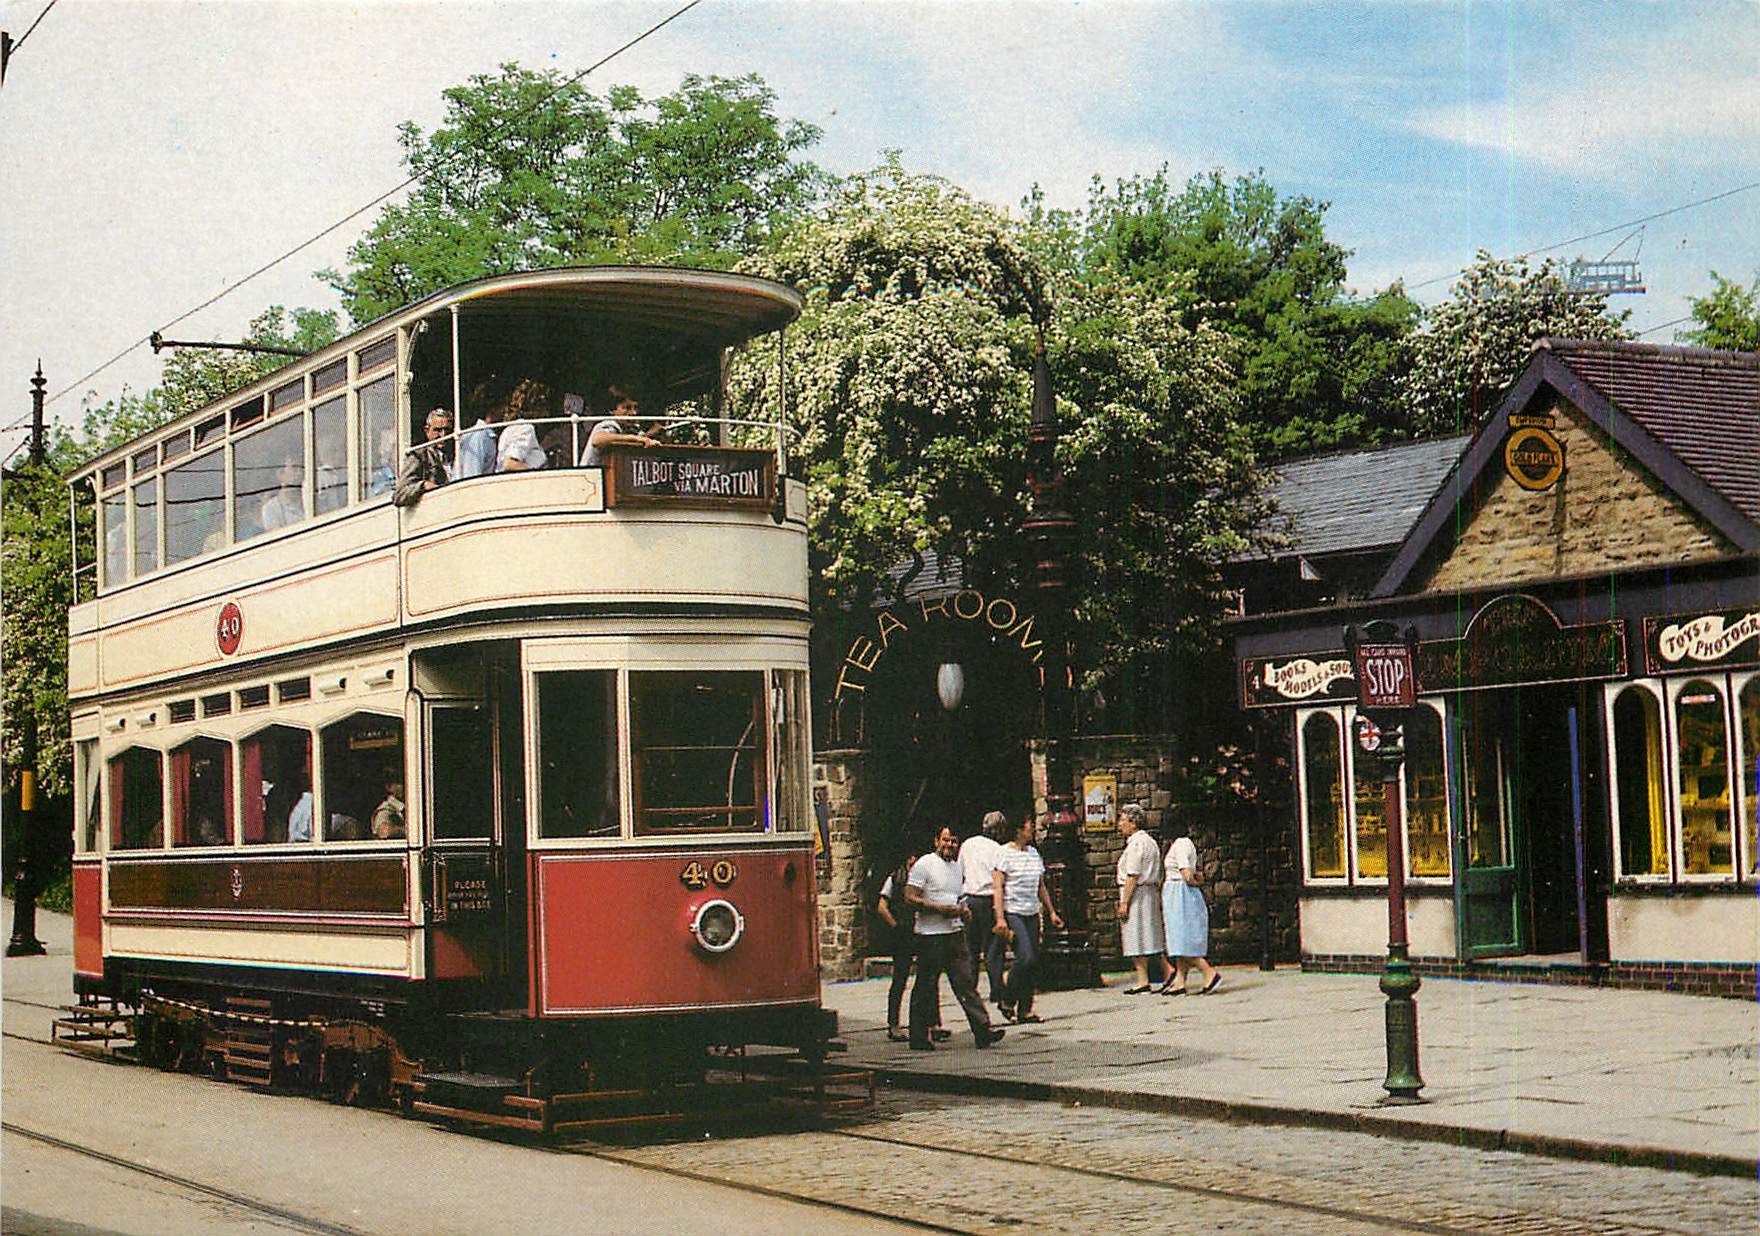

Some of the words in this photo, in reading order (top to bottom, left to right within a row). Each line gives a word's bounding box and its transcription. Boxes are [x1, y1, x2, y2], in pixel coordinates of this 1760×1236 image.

[632, 460, 674, 487] TALBOT
[678, 462, 720, 480] SQUARE
[673, 481, 692, 493] VIA
[695, 469, 759, 496] MARTON
[221, 616, 240, 638] 40
[1666, 622, 1701, 653] TOYS
[835, 611, 909, 700] TEA
[1274, 661, 1309, 684] BOOKS
[1284, 671, 1323, 694] MODELS
[1329, 661, 1355, 676] SOU
[1366, 658, 1404, 695] STOP
[453, 880, 487, 890] PLEASE
[681, 861, 737, 887] 40
